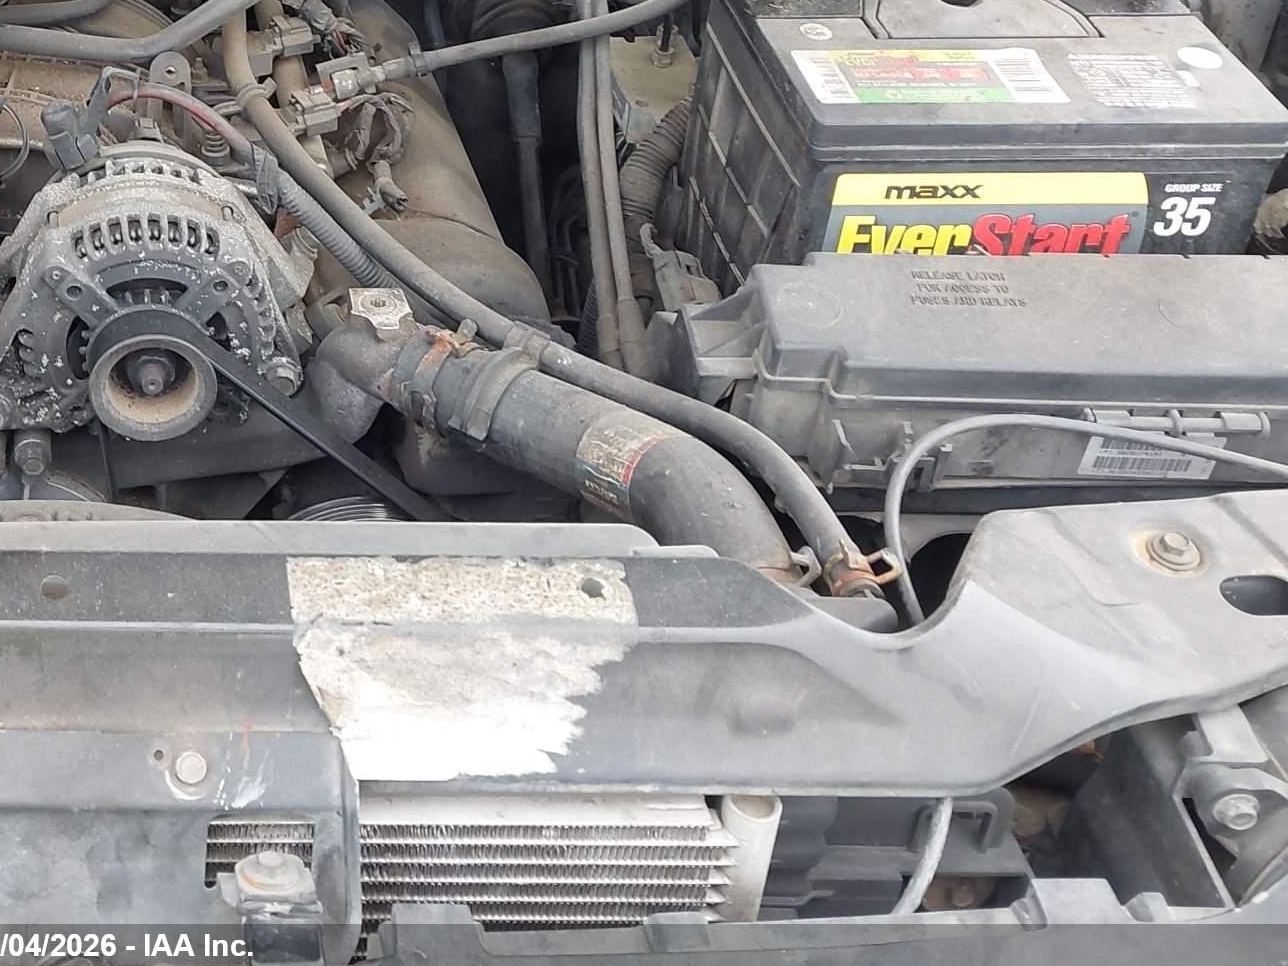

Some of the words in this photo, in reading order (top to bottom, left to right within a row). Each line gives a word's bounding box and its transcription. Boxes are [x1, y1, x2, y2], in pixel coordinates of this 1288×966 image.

[884, 184, 984, 200] maxx
[1164, 183, 1201, 193] GROUP
[1201, 182, 1224, 193] SIZE
[1153, 196, 1216, 237] 35
[837, 213, 1131, 256] EverStart
[910, 270, 963, 281] RELEASE
[966, 271, 1006, 282] LATCH
[916, 283, 942, 293] FOR
[944, 283, 991, 294] ACCESS
[992, 284, 1010, 294] TO
[910, 295, 950, 306] FUSES
[952, 296, 977, 306] AND
[979, 297, 1027, 307] RELAYS
